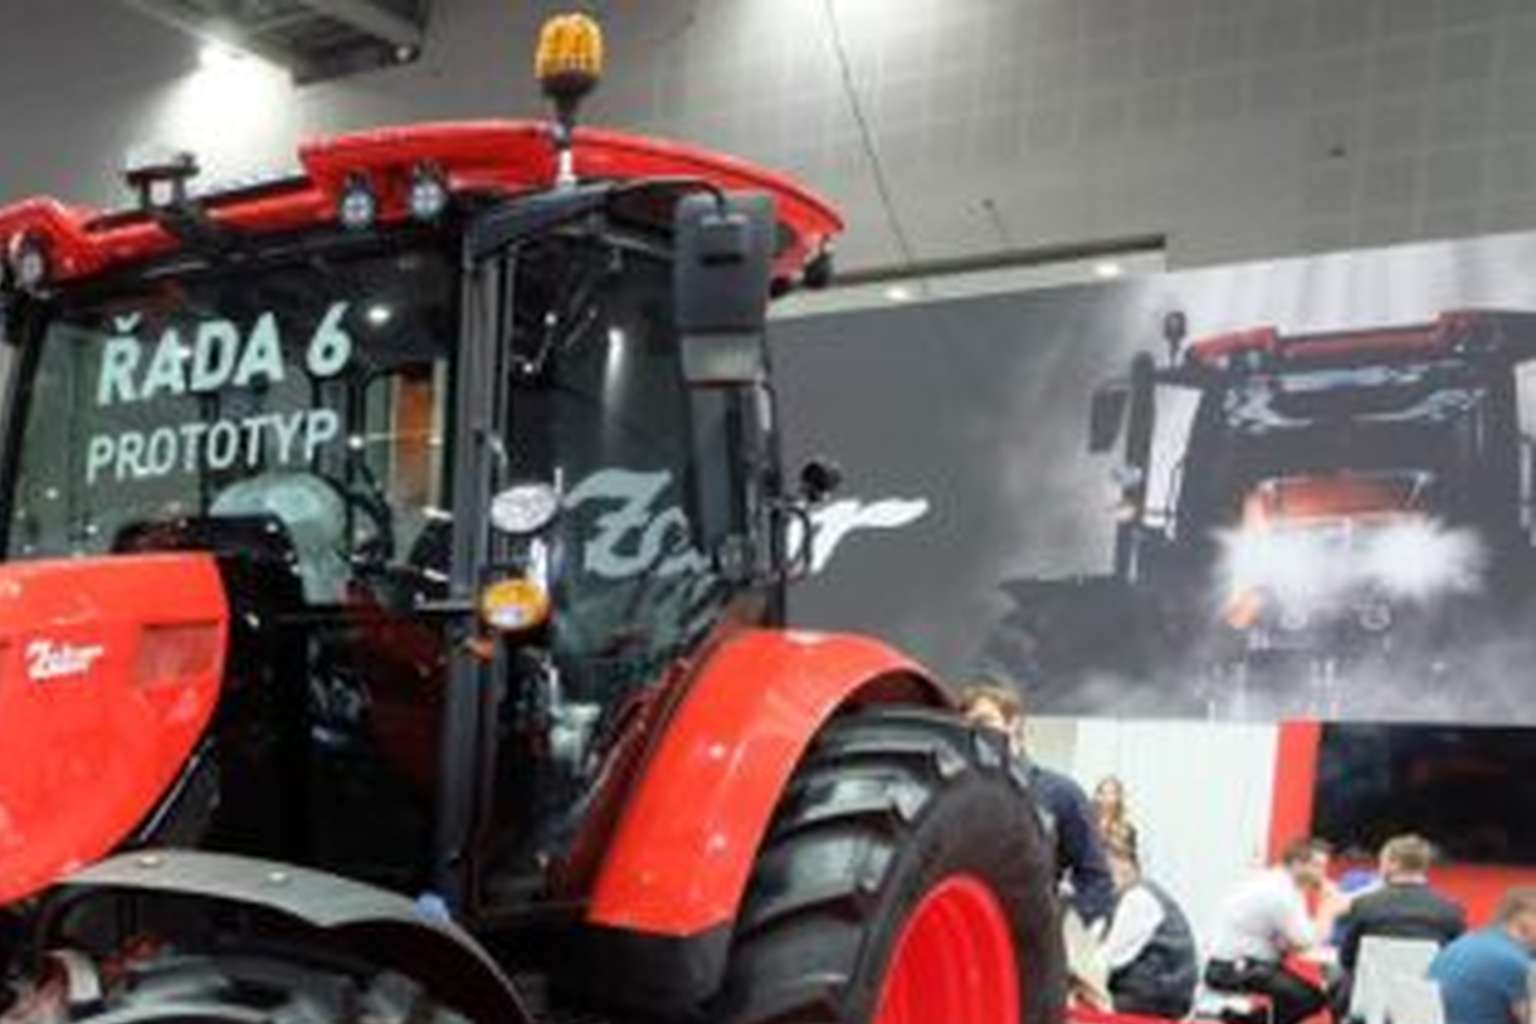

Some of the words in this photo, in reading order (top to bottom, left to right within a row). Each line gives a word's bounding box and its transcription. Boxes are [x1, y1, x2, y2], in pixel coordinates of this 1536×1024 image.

[96, 311, 285, 407] ŘADA
[306, 301, 352, 377] 6
[85, 408, 339, 485] PROTOTYP
